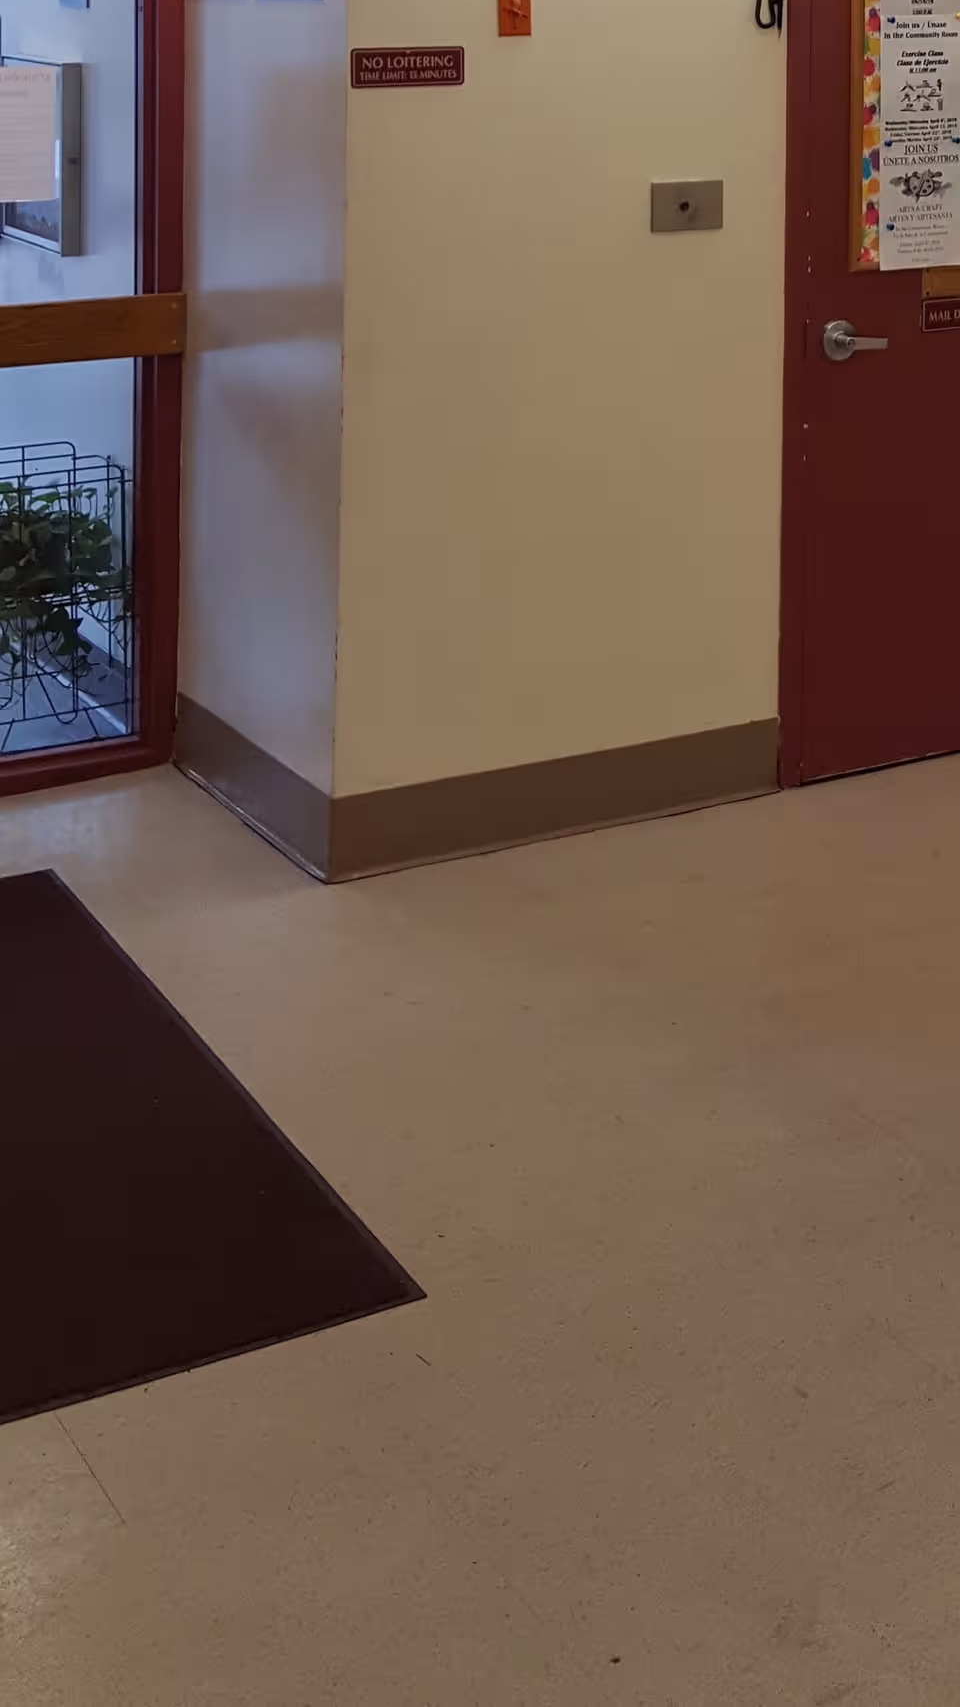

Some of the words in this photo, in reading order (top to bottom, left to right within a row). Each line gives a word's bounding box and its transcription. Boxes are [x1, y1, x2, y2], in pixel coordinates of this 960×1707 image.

[884, 32, 891, 40] In
[892, 31, 904, 39] the
[905, 31, 940, 40] Community
[941, 30, 959, 38] Room
[362, 57, 383, 69] NO
[387, 55, 454, 69] LOITERING
[897, 59, 913, 67] Clase
[923, 58, 949, 67] Ejercicio
[360, 71, 380, 81] TIME
[382, 70, 407, 80] LIMIT:
[410, 70, 418, 79] 15
[420, 69, 457, 79] MINUTES
[904, 144, 925, 155] JOIN
[927, 144, 939, 154] US
[911, 157, 916, 165] A
[918, 155, 959, 164] NOSOTROS
[929, 310, 952, 322] MAIL
